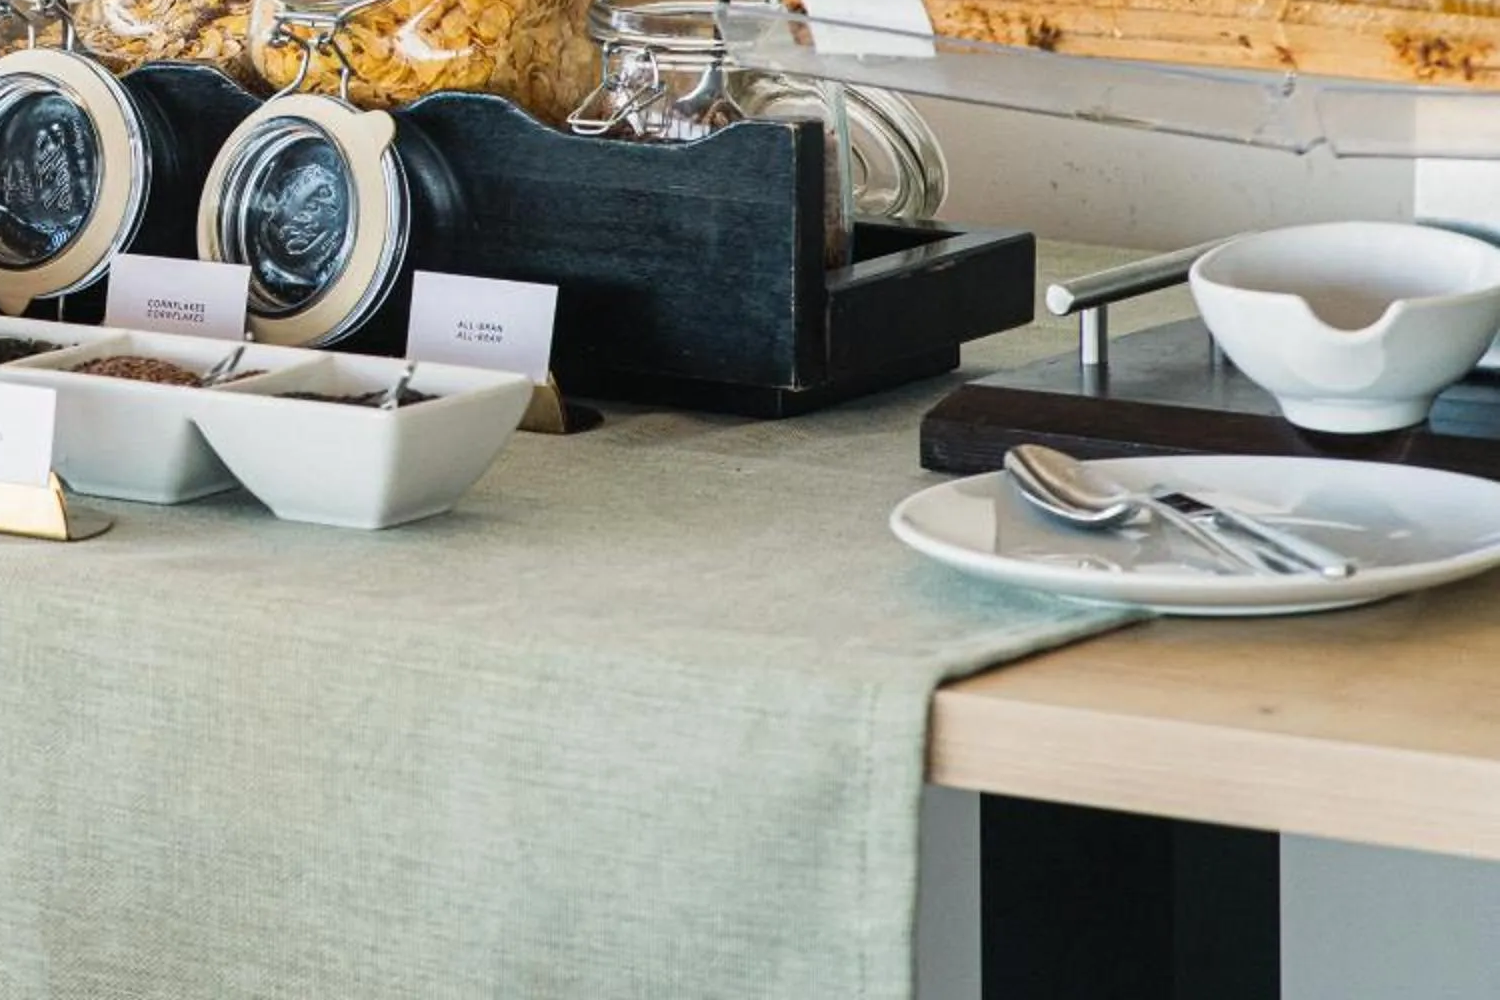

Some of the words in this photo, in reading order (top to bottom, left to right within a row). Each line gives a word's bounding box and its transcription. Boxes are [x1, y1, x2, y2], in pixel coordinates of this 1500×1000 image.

[146, 299, 205, 313] CORNFLAKES
[146, 309, 205, 322] CORNFLAKES
[456, 320, 503, 332] ALL-BRAN
